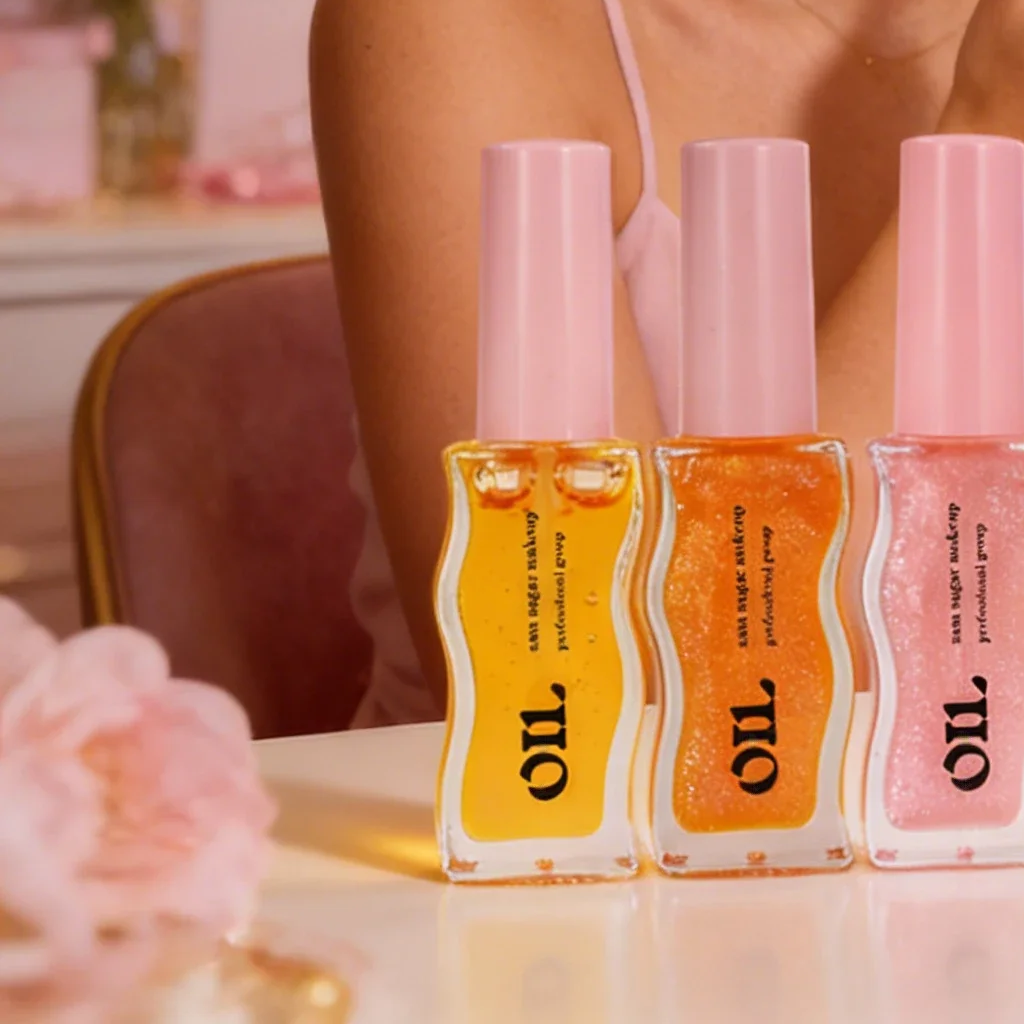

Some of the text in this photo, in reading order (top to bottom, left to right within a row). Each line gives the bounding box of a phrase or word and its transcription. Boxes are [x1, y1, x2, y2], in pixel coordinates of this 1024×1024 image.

[519, 682, 569, 801] OIL
[730, 678, 779, 795] OIL
[943, 675, 990, 792] OIL
